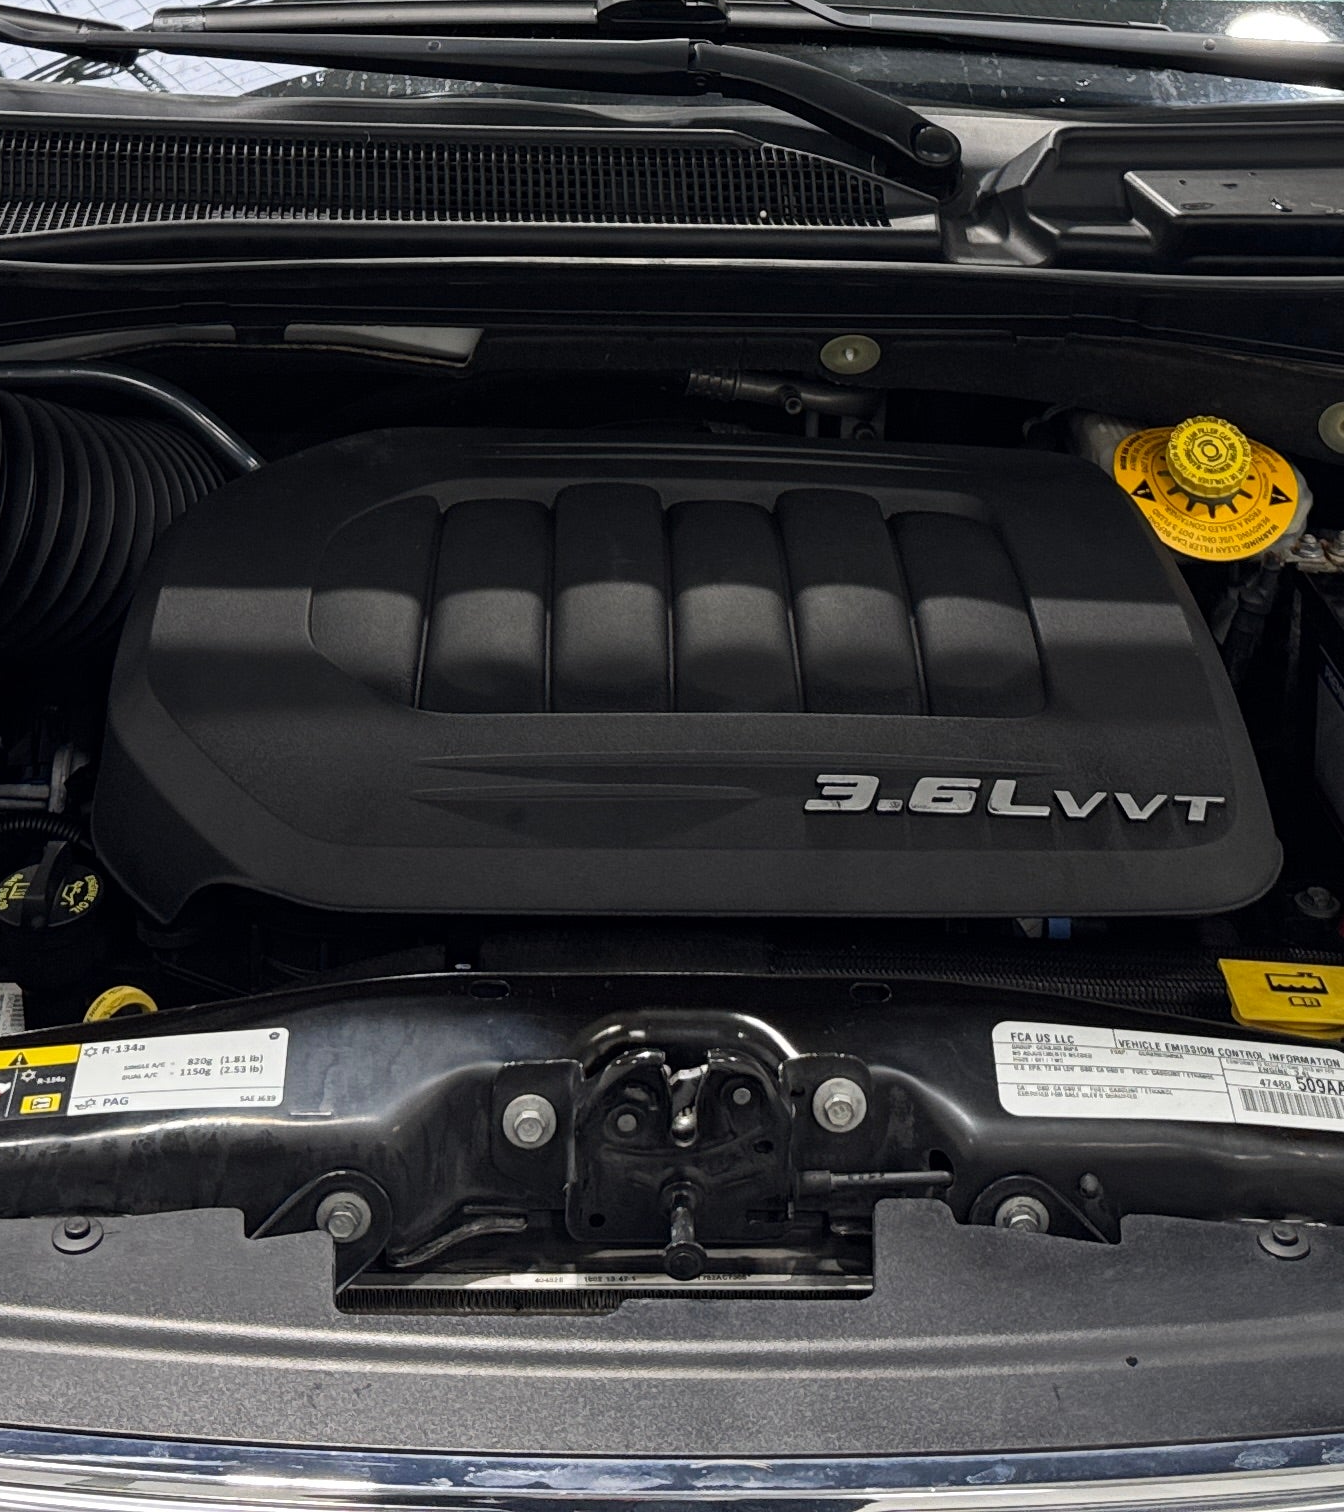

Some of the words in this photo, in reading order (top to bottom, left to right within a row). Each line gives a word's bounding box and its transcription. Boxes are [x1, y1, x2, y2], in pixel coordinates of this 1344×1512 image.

[1219, 432, 1232, 441] CAP
[1245, 508, 1262, 524] FROM
[1179, 528, 1194, 539] DOT
[1208, 523, 1236, 533] SEALED
[1172, 536, 1188, 547] CAP
[1196, 532, 1217, 543] ONLY
[1189, 543, 1214, 553] FILLER
[1215, 544, 1241, 554] CLEAN
[69, 901, 90, 914] OIL
[1011, 1032, 1032, 1042] FCA
[1036, 1033, 1050, 1043] US
[1054, 1034, 1074, 1044] LLC
[102, 1043, 146, 1055] R-134a
[1118, 1039, 1160, 1050] VEHICLE
[1165, 1042, 1215, 1056] EMISSION
[1218, 1048, 1264, 1060] CONTROL
[1269, 1053, 1341, 1068] INFORMATION
[249, 1054, 264, 1064] lb)
[179, 1068, 212, 1077] 1150g
[219, 1066, 247, 1075] (2.53
[249, 1065, 264, 1074] lb)
[102, 1096, 129, 1107] PAG
